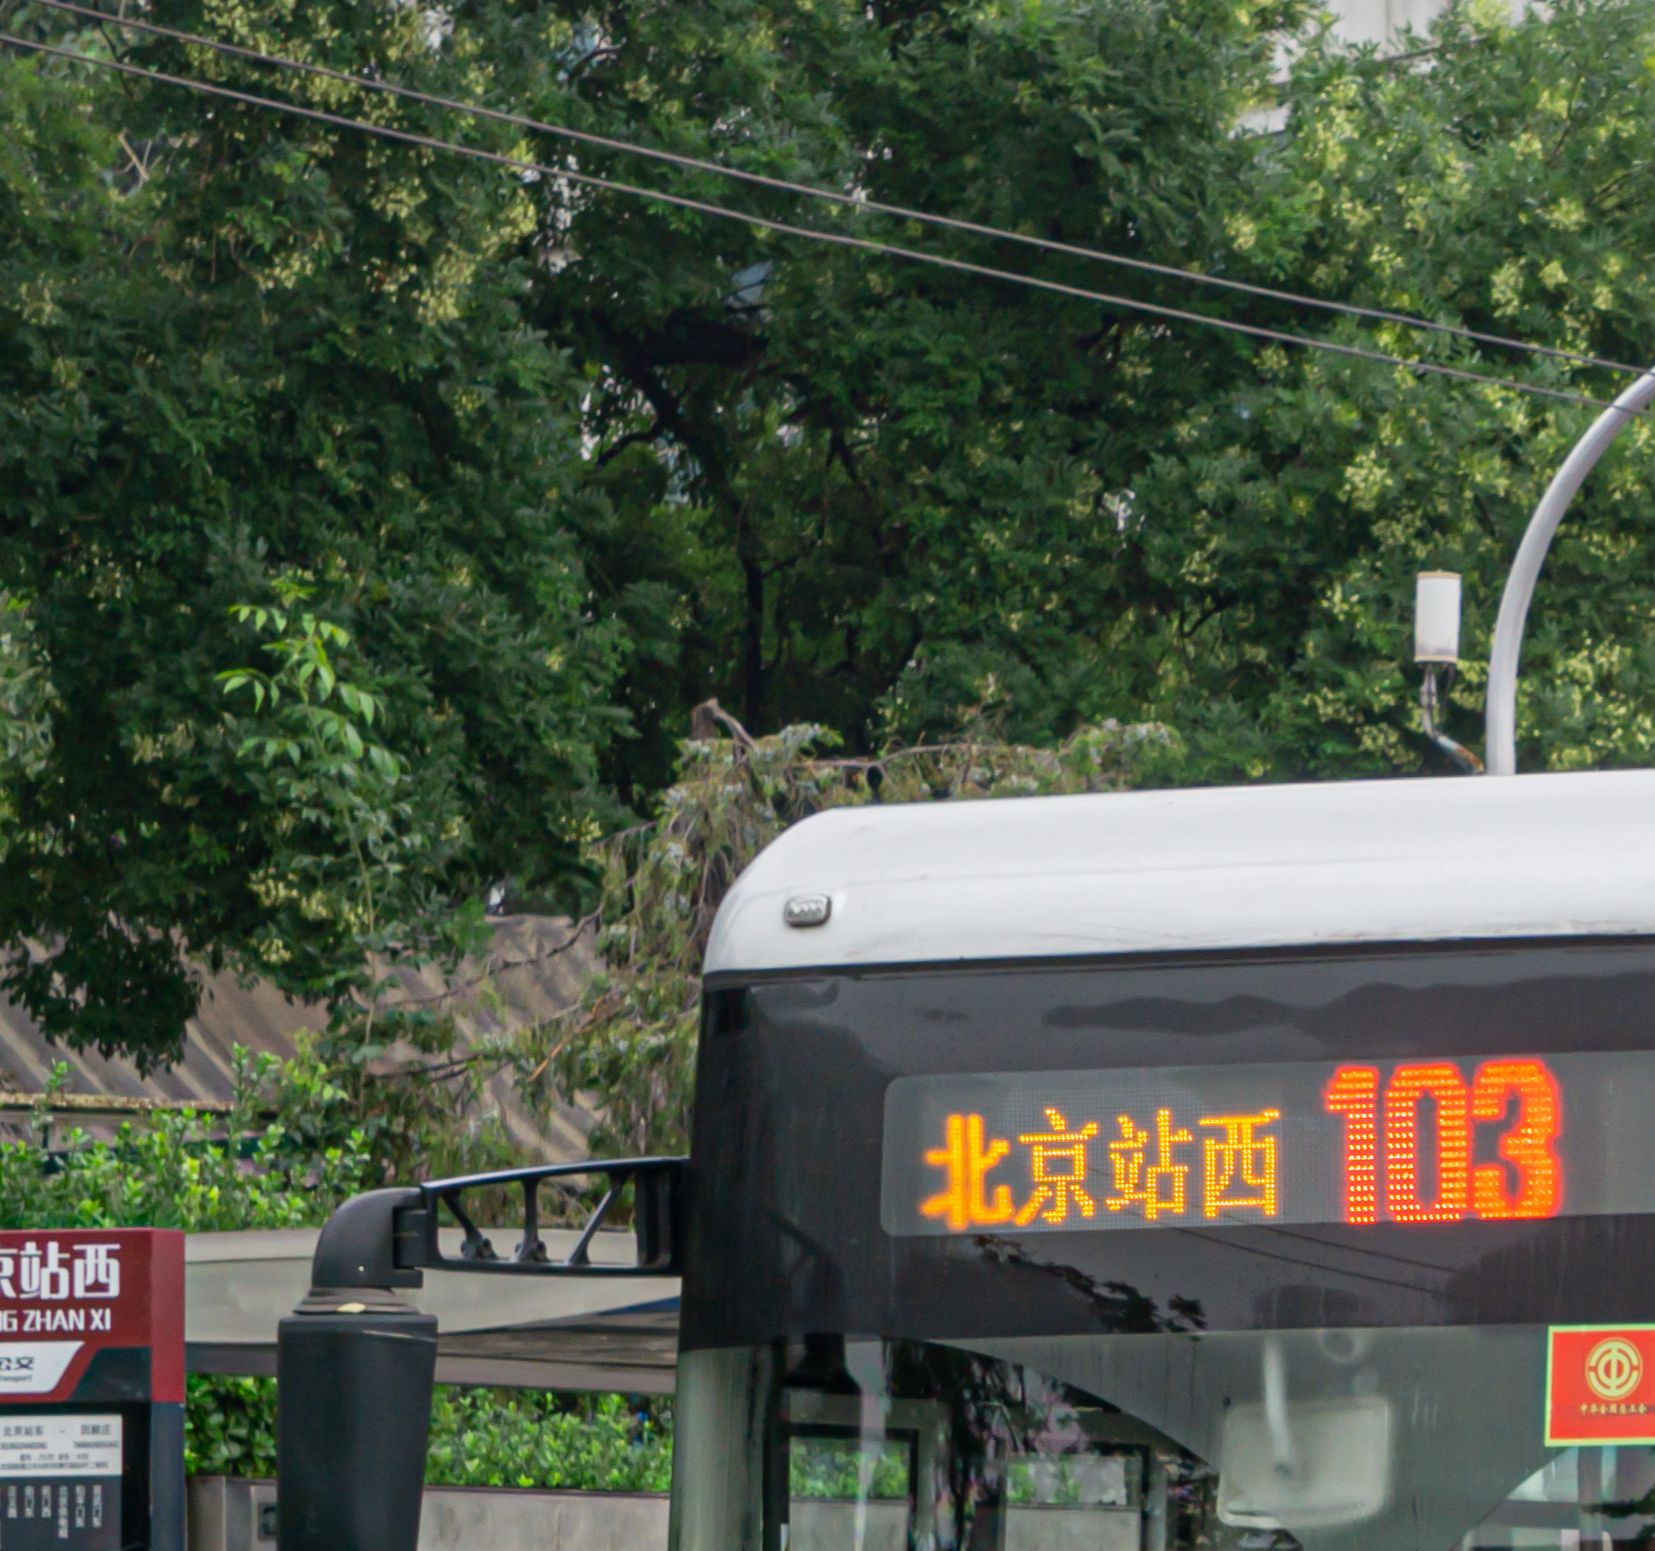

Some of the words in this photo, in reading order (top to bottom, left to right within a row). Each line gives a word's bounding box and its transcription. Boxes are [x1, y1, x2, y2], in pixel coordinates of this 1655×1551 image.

[922, 1109, 1281, 1231] 北京站西
[1325, 1059, 1563, 1224] 103
[22, 1309, 85, 1332] ZHAN
[90, 1308, 111, 1331] XI
